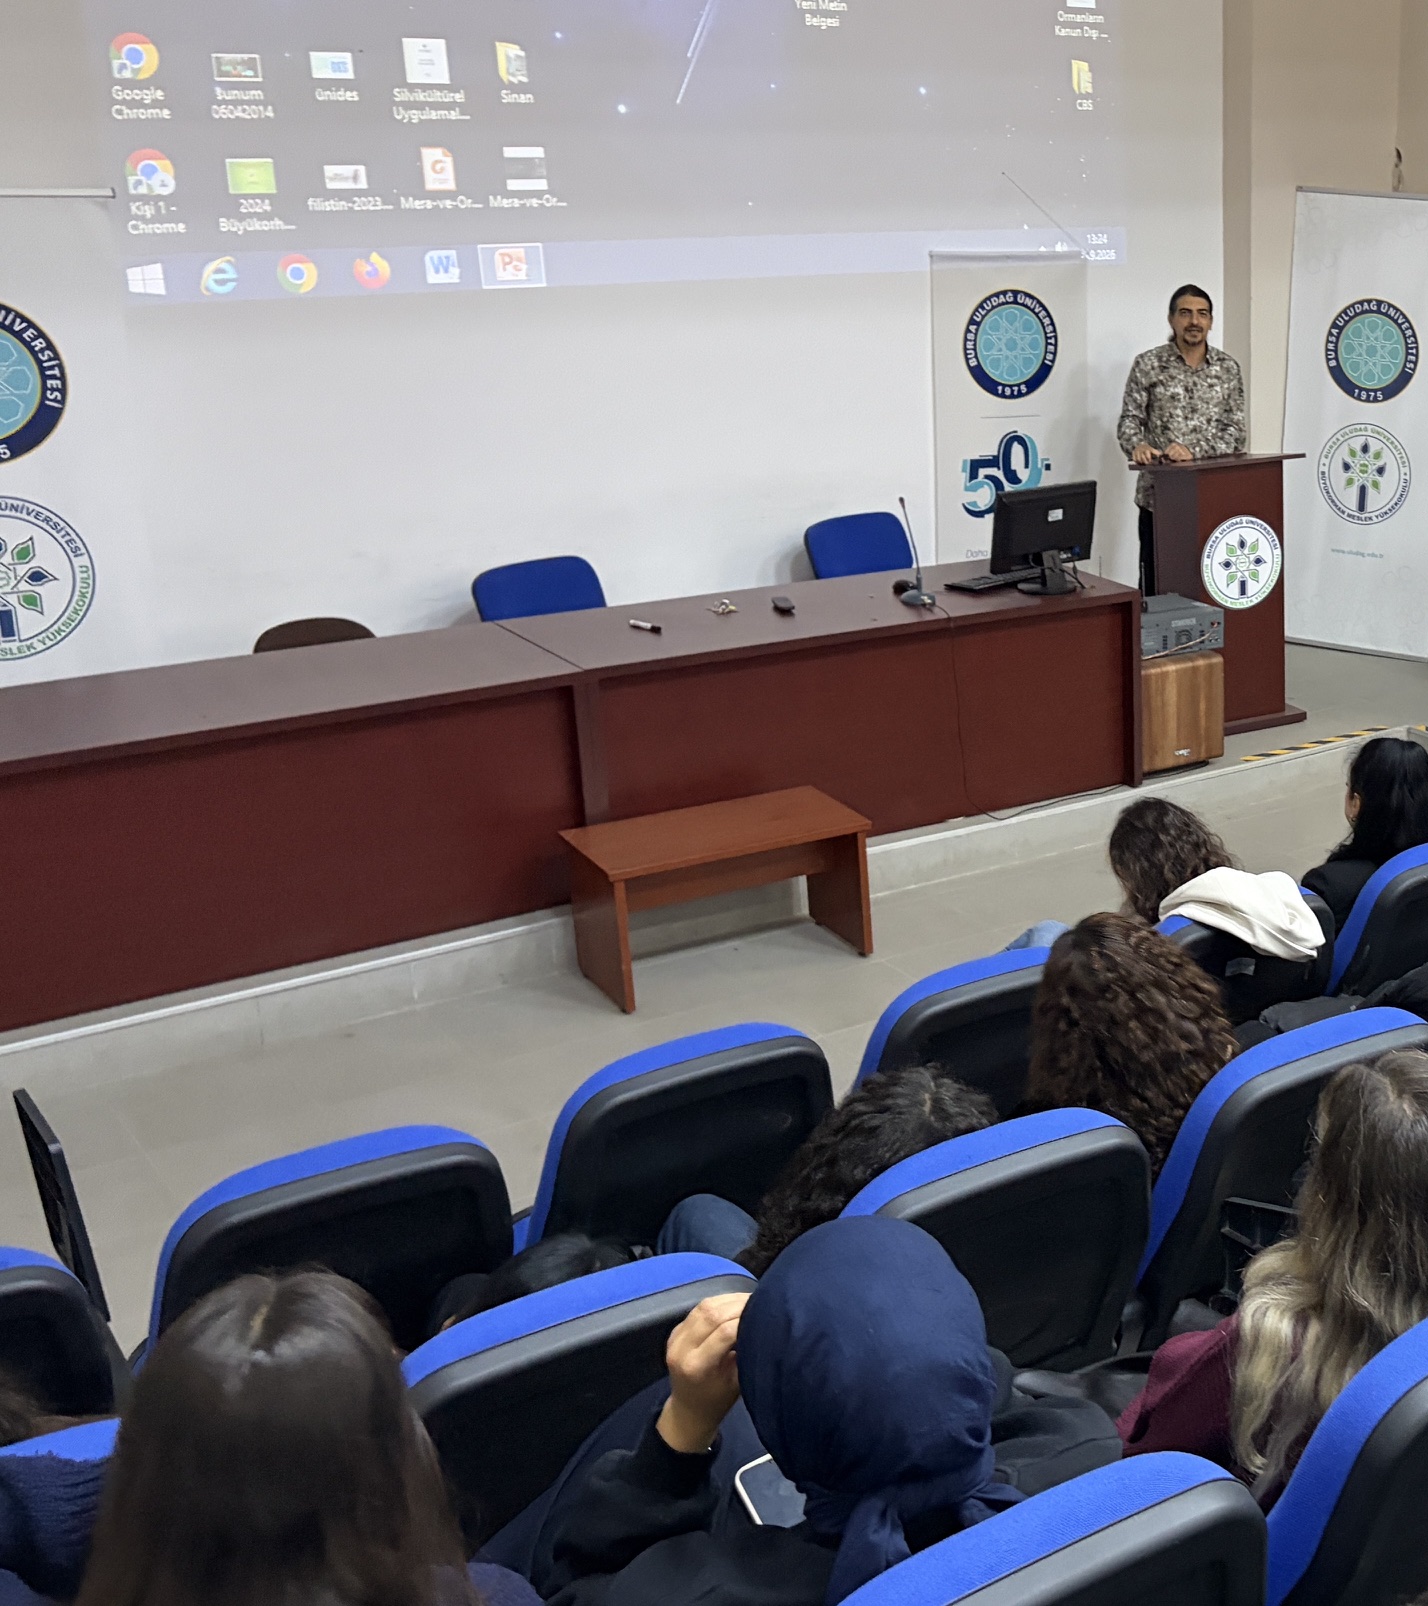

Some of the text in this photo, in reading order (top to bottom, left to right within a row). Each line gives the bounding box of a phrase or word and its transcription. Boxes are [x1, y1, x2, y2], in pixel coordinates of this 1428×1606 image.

[805, 13, 840, 30] Belgesi
[1054, 25, 1082, 37] Kanun
[111, 86, 165, 103] Google
[500, 89, 535, 103] Sinan
[111, 104, 172, 120] Chrome
[1076, 99, 1094, 111] CBS
[239, 199, 272, 213] 2024
[127, 219, 187, 234] Chrome
[965, 325, 978, 367] BURSA
[973, 292, 1014, 323] ULUDAĞ
[1326, 328, 1339, 367] BURSA
[1335, 301, 1378, 326] ULUDAĞ
[997, 384, 1028, 396] 1975
[1353, 388, 1384, 401] 1975
[1323, 436, 1342, 460] BURSA
[1340, 425, 1369, 439] ULUDAĞ
[1346, 512, 1374, 523] MESLEK
[1374, 477, 1409, 521] YÜKSEKOKULU
[1206, 535, 1220, 560] BURSA
[37, 564, 90, 648] YÜKSEKOKULU
